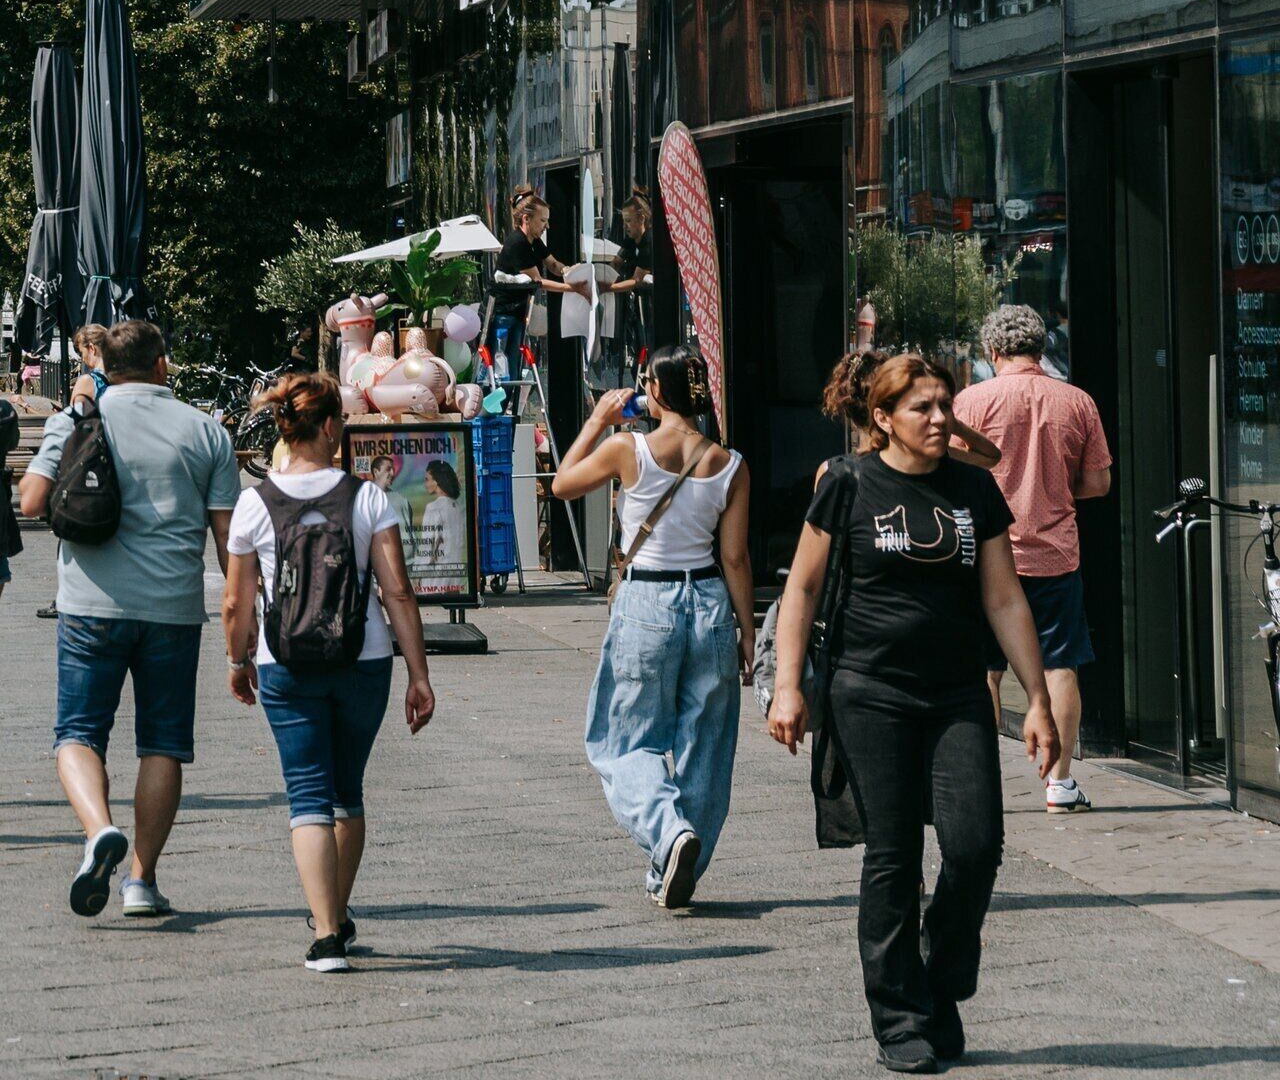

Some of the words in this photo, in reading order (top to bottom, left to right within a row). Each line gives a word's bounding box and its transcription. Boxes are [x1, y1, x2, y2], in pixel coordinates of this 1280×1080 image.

[1237, 287, 1264, 311] Damen
[1238, 354, 1266, 379] Schuhe
[1239, 386, 1264, 412] Herren
[1239, 421, 1264, 446] Kinder
[354, 440, 376, 456] WIR
[378, 438, 423, 456] SUCHEN
[425, 437, 451, 454] DICH
[1240, 454, 1263, 480] Home
[880, 532, 911, 552] TRUE
[952, 508, 976, 568] RELIGION
